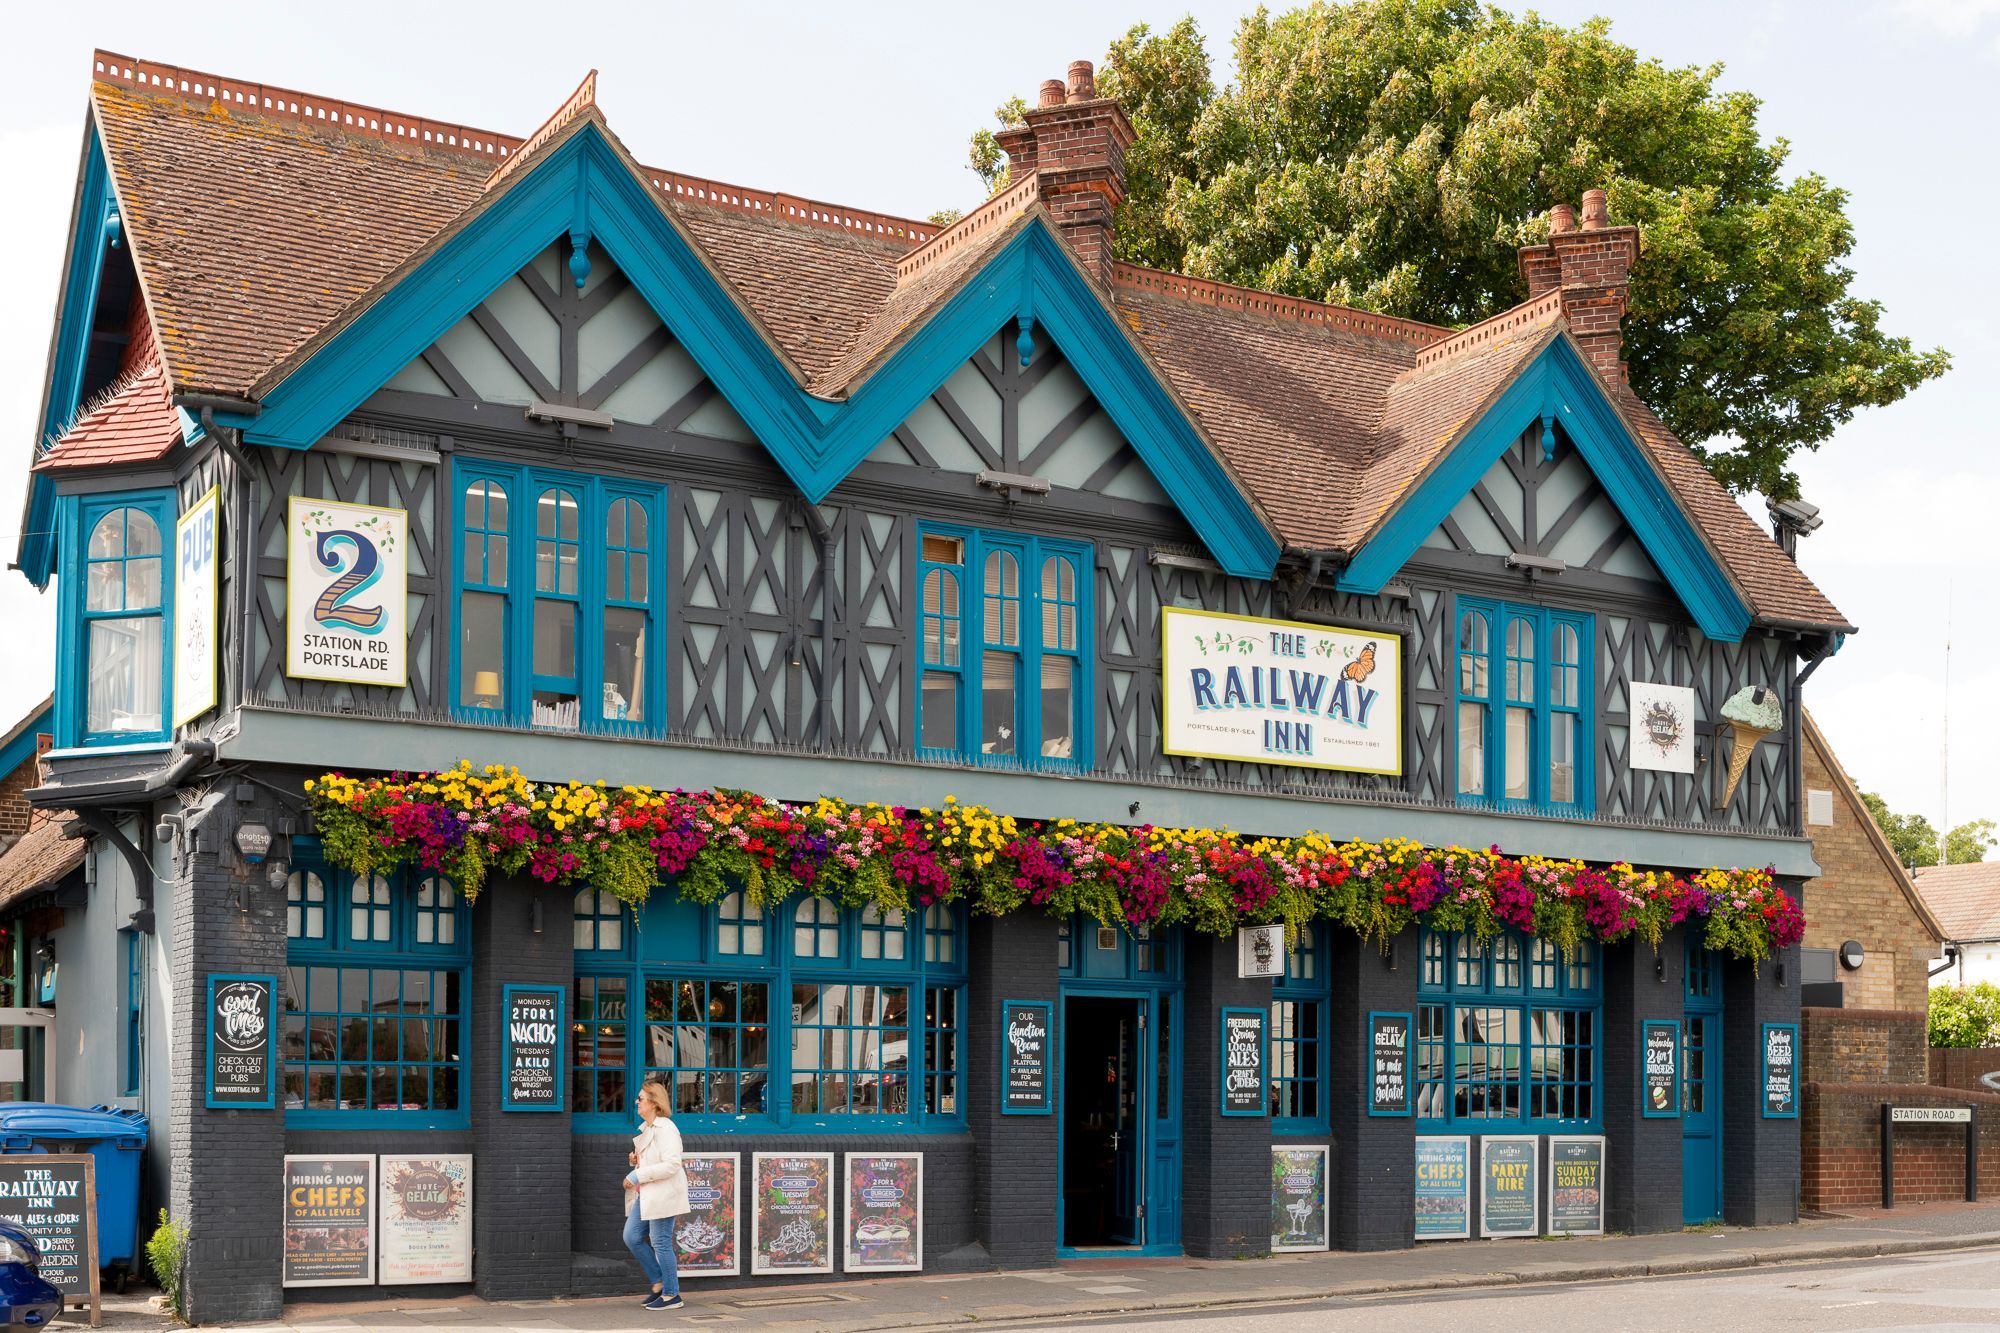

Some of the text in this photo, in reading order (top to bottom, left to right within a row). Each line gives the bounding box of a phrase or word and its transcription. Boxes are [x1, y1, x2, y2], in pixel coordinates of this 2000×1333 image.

[183, 509, 213, 582] PUB
[314, 529, 389, 635] 2
[304, 633, 390, 654] STATION RD.
[1270, 631, 1307, 658] THE
[303, 651, 388, 671] PORTSLADE
[1189, 665, 1380, 729] RAILWAY
[1187, 723, 1256, 735] PORTSLADE-BY-SEA
[1263, 719, 1314, 757] INN
[1323, 736, 1364, 746] ESTABLISHED
[239, 833, 269, 841] Brighton
[1257, 965, 1270, 973] HERE
[223, 989, 261, 1014] Good
[513, 1008, 555, 1020] 2 FOR 1
[1019, 1013, 1034, 1021] OUR
[217, 1005, 265, 1038] Times
[1228, 1018, 1261, 1029] FREEHOUSE
[511, 1022, 556, 1045] NACHOS
[1230, 1027, 1257, 1044] Serving
[227, 1034, 240, 1045] PUBS
[1015, 1037, 1040, 1055] Room
[1228, 1043, 1259, 1052] LOCAL
[1767, 1045, 1793, 1057] BEER
[219, 1057, 263, 1066] CHECK OUT
[1228, 1051, 1260, 1068] ALES
[1647, 1048, 1674, 1065] 2 for 1
[1767, 1056, 1792, 1066] GARDEN
[516, 1057, 550, 1068] A KILO
[1377, 1059, 1402, 1073] We make
[235, 1066, 261, 1074] OTHER
[516, 1069, 549, 1077] CHICKEN
[1232, 1069, 1255, 1078] CRAFT
[1647, 1064, 1675, 1075] BURGERS
[231, 1074, 249, 1082] PUBS
[1227, 1075, 1260, 1092] CIDERS
[1376, 1074, 1403, 1085] our own
[1376, 1084, 1404, 1104] gelato!
[1767, 1084, 1791, 1093] COCKTAIL
[1894, 1110, 1955, 1119] STATION ROAD
[685, 1161, 714, 1169] RAILWAY
[1491, 1163, 1529, 1178] PARTY
[25, 1169, 52, 1181] THE
[1417, 1163, 1465, 1180] CHEFS
[1557, 1166, 1597, 1177] SUNDAY
[292, 1175, 364, 1185] HIRING NOW
[1497, 1178, 1525, 1192] HIRE
[1558, 1177, 1596, 1187] ROAST?
[0, 1180, 80, 1197] RAILWAY
[417, 1183, 438, 1191] HOVE
[290, 1186, 366, 1208] CHEFS
[28, 1198, 54, 1208] INN
[295, 1209, 361, 1217] OF ALL LEVELS
[26, 1214, 46, 1225] ALES
[54, 1214, 80, 1224] CIDERS
[40, 1255, 79, 1266] ARDEN
